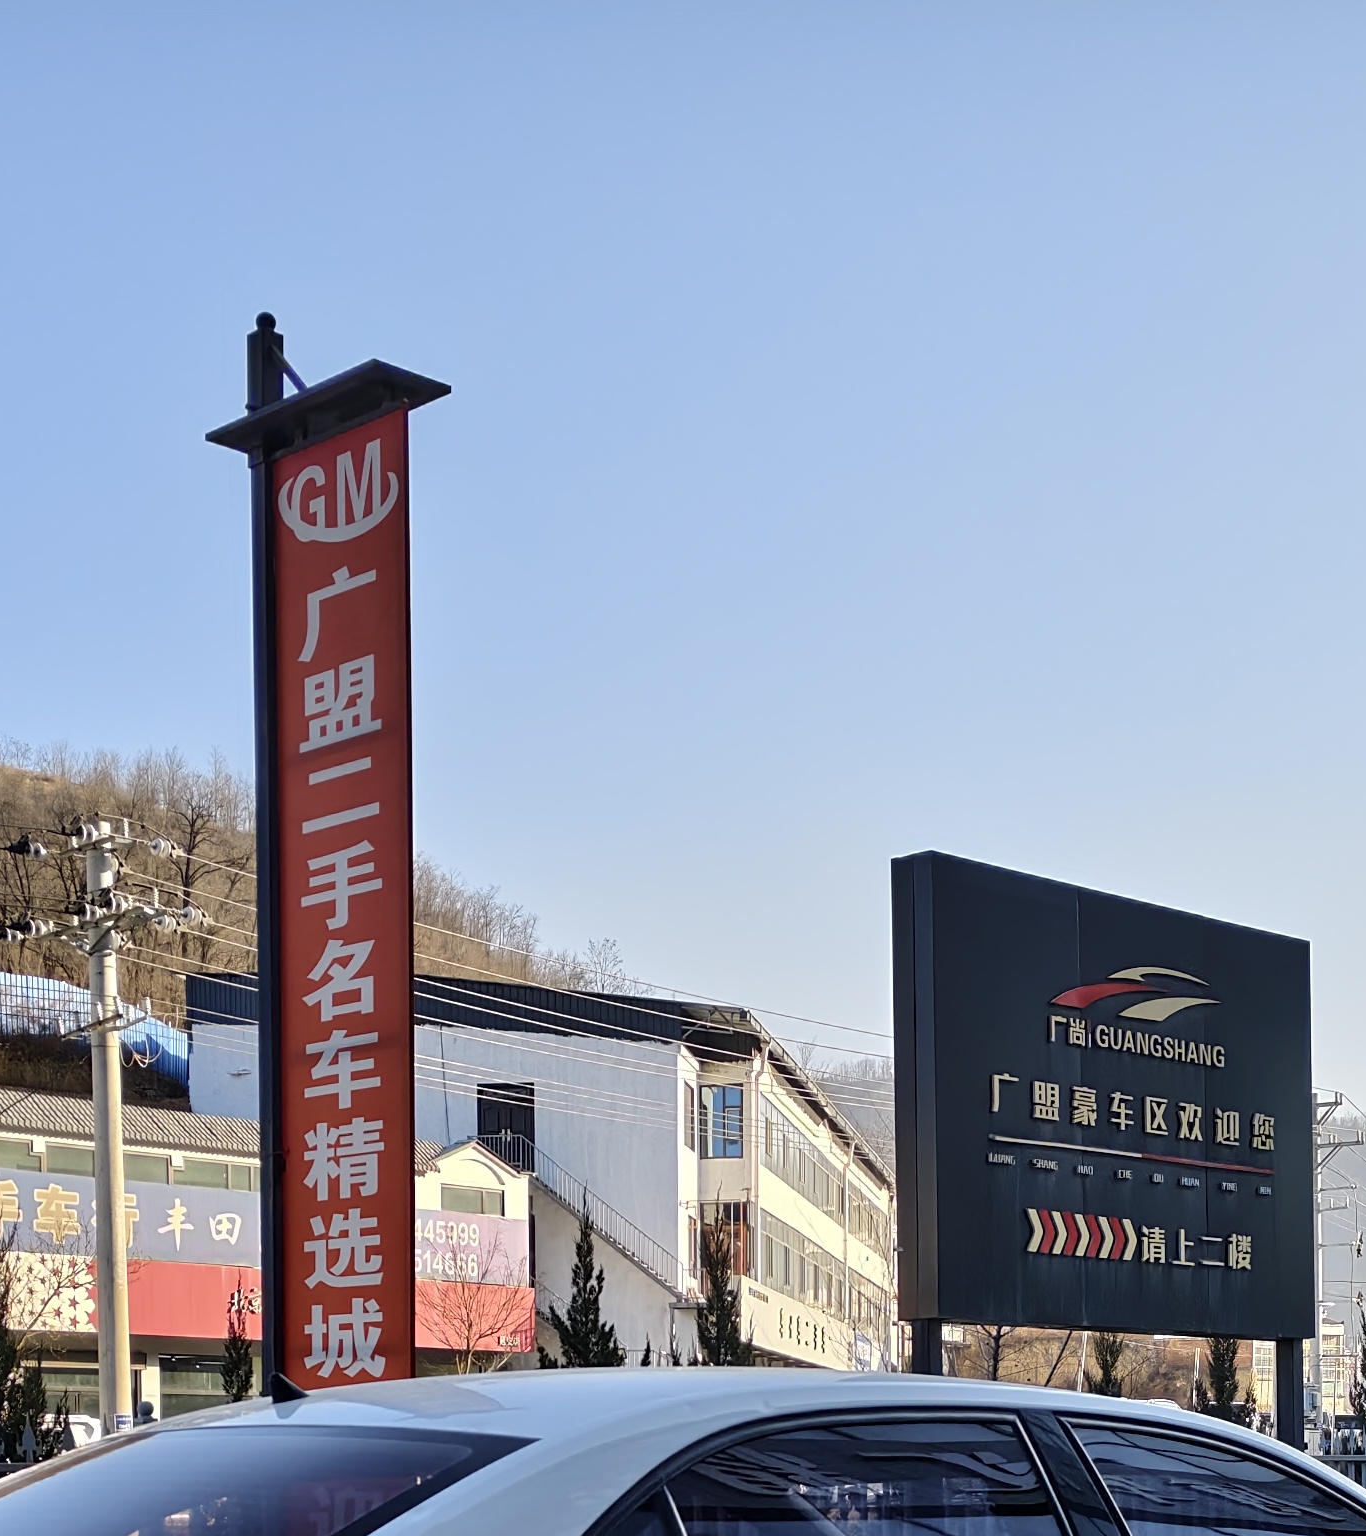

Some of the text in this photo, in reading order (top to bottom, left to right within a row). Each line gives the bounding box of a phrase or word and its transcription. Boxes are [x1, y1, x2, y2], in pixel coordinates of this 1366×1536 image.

[292, 438, 383, 532] GM
[297, 566, 385, 1378] 广盟二手名车精选城
[1049, 1015, 1225, 1068] 广尚 GUANGSHANG
[990, 1072, 1275, 1151] 广盟豪车区欢迎您
[157, 1198, 242, 1252] 丰田
[1140, 1225, 1252, 1270] 请上二楼
